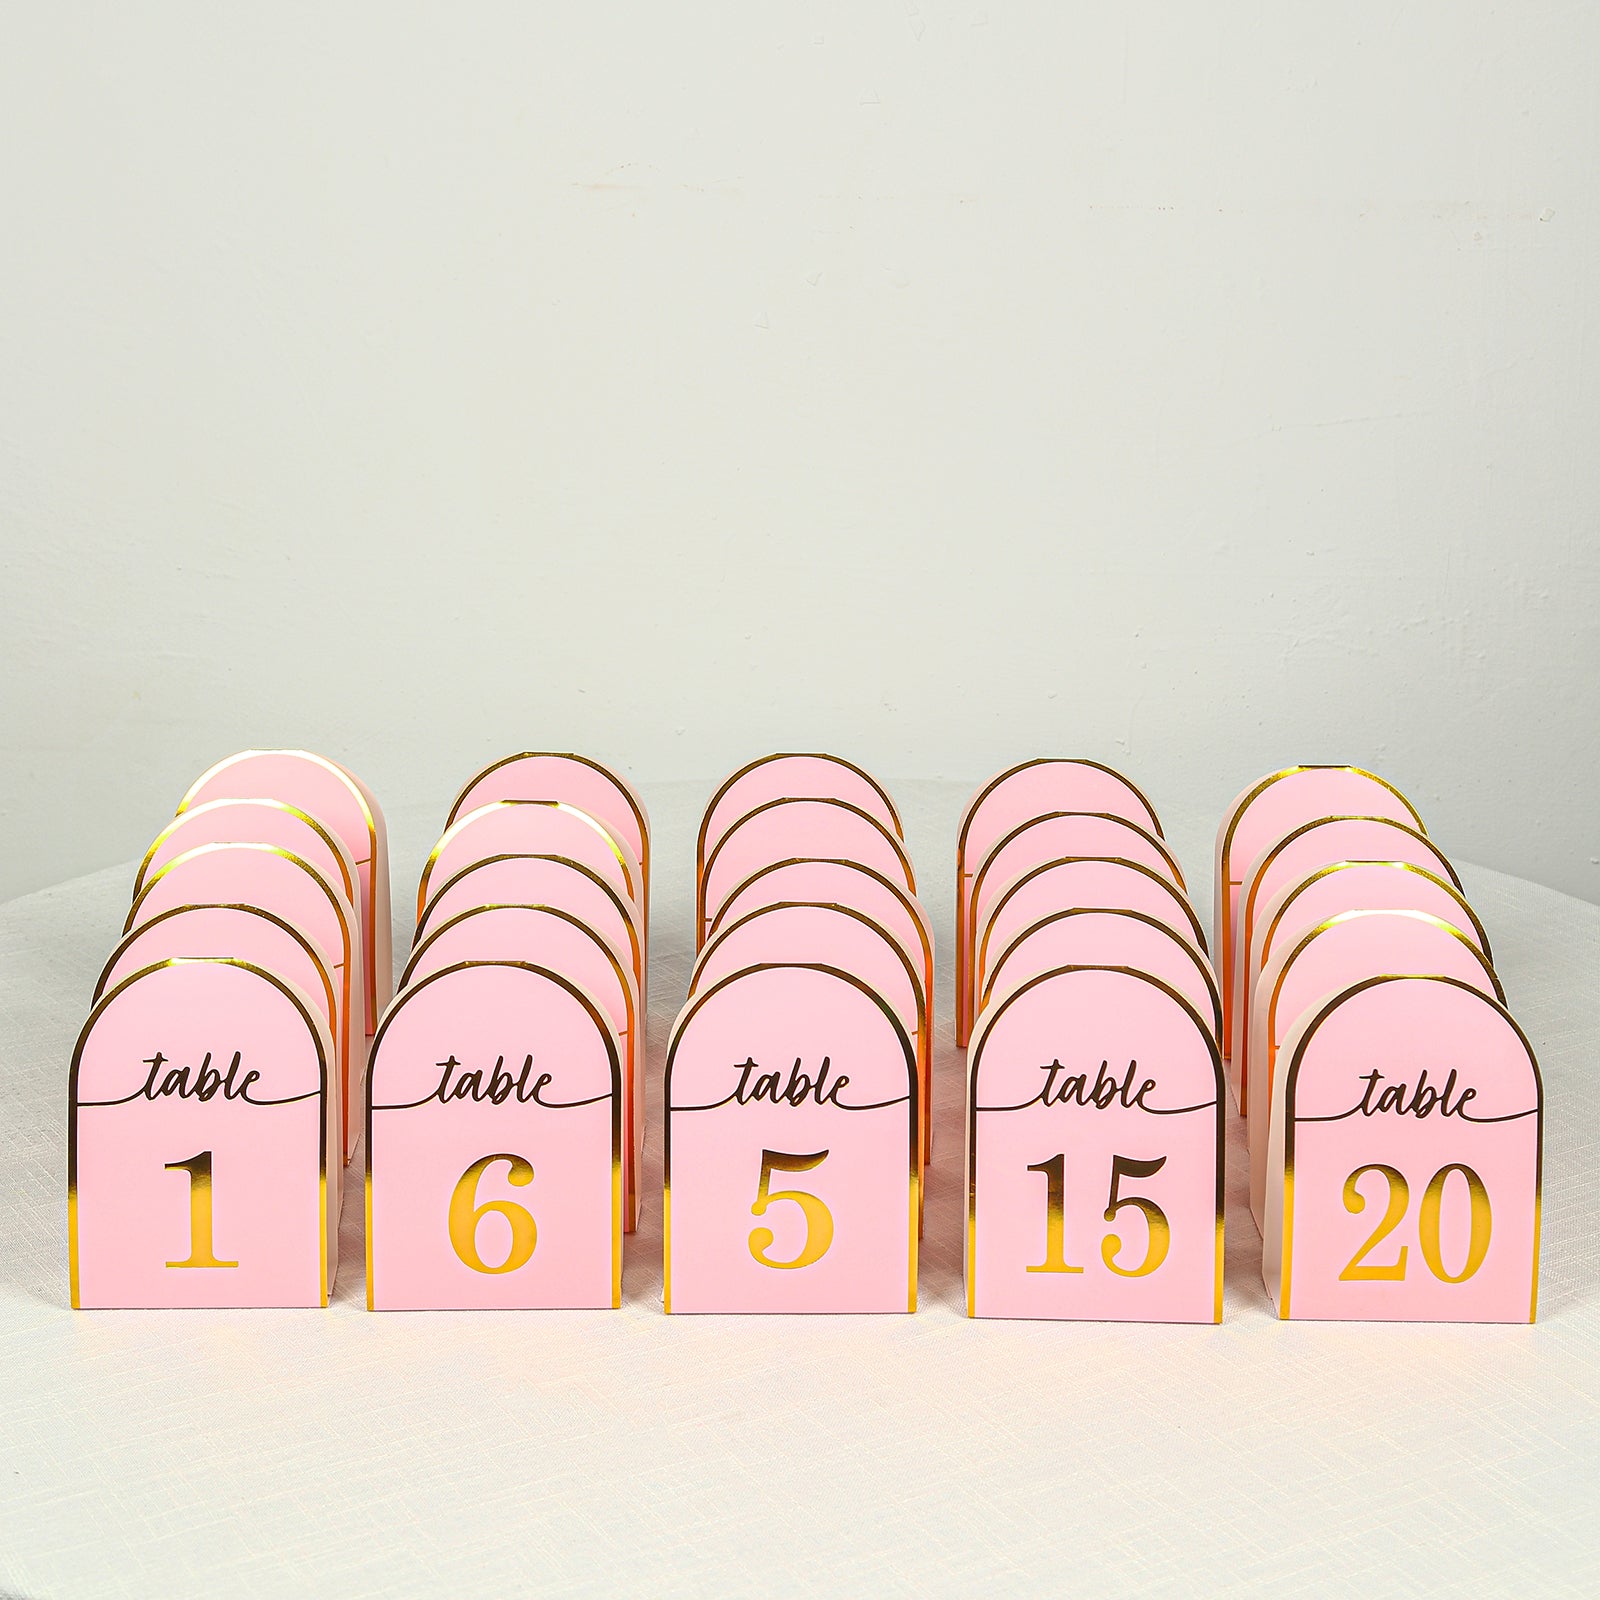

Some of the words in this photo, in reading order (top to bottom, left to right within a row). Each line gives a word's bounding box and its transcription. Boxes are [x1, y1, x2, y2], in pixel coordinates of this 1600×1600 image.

[137, 1051, 264, 1106] table
[430, 1055, 556, 1109] table
[728, 1056, 853, 1110] table
[1034, 1058, 1160, 1114] table
[1353, 1068, 1480, 1122] table
[164, 1150, 239, 1268] 1
[448, 1153, 538, 1274] 6
[748, 1148, 834, 1270] 5
[1026, 1153, 1171, 1278] 15
[1338, 1163, 1492, 1284] 20
